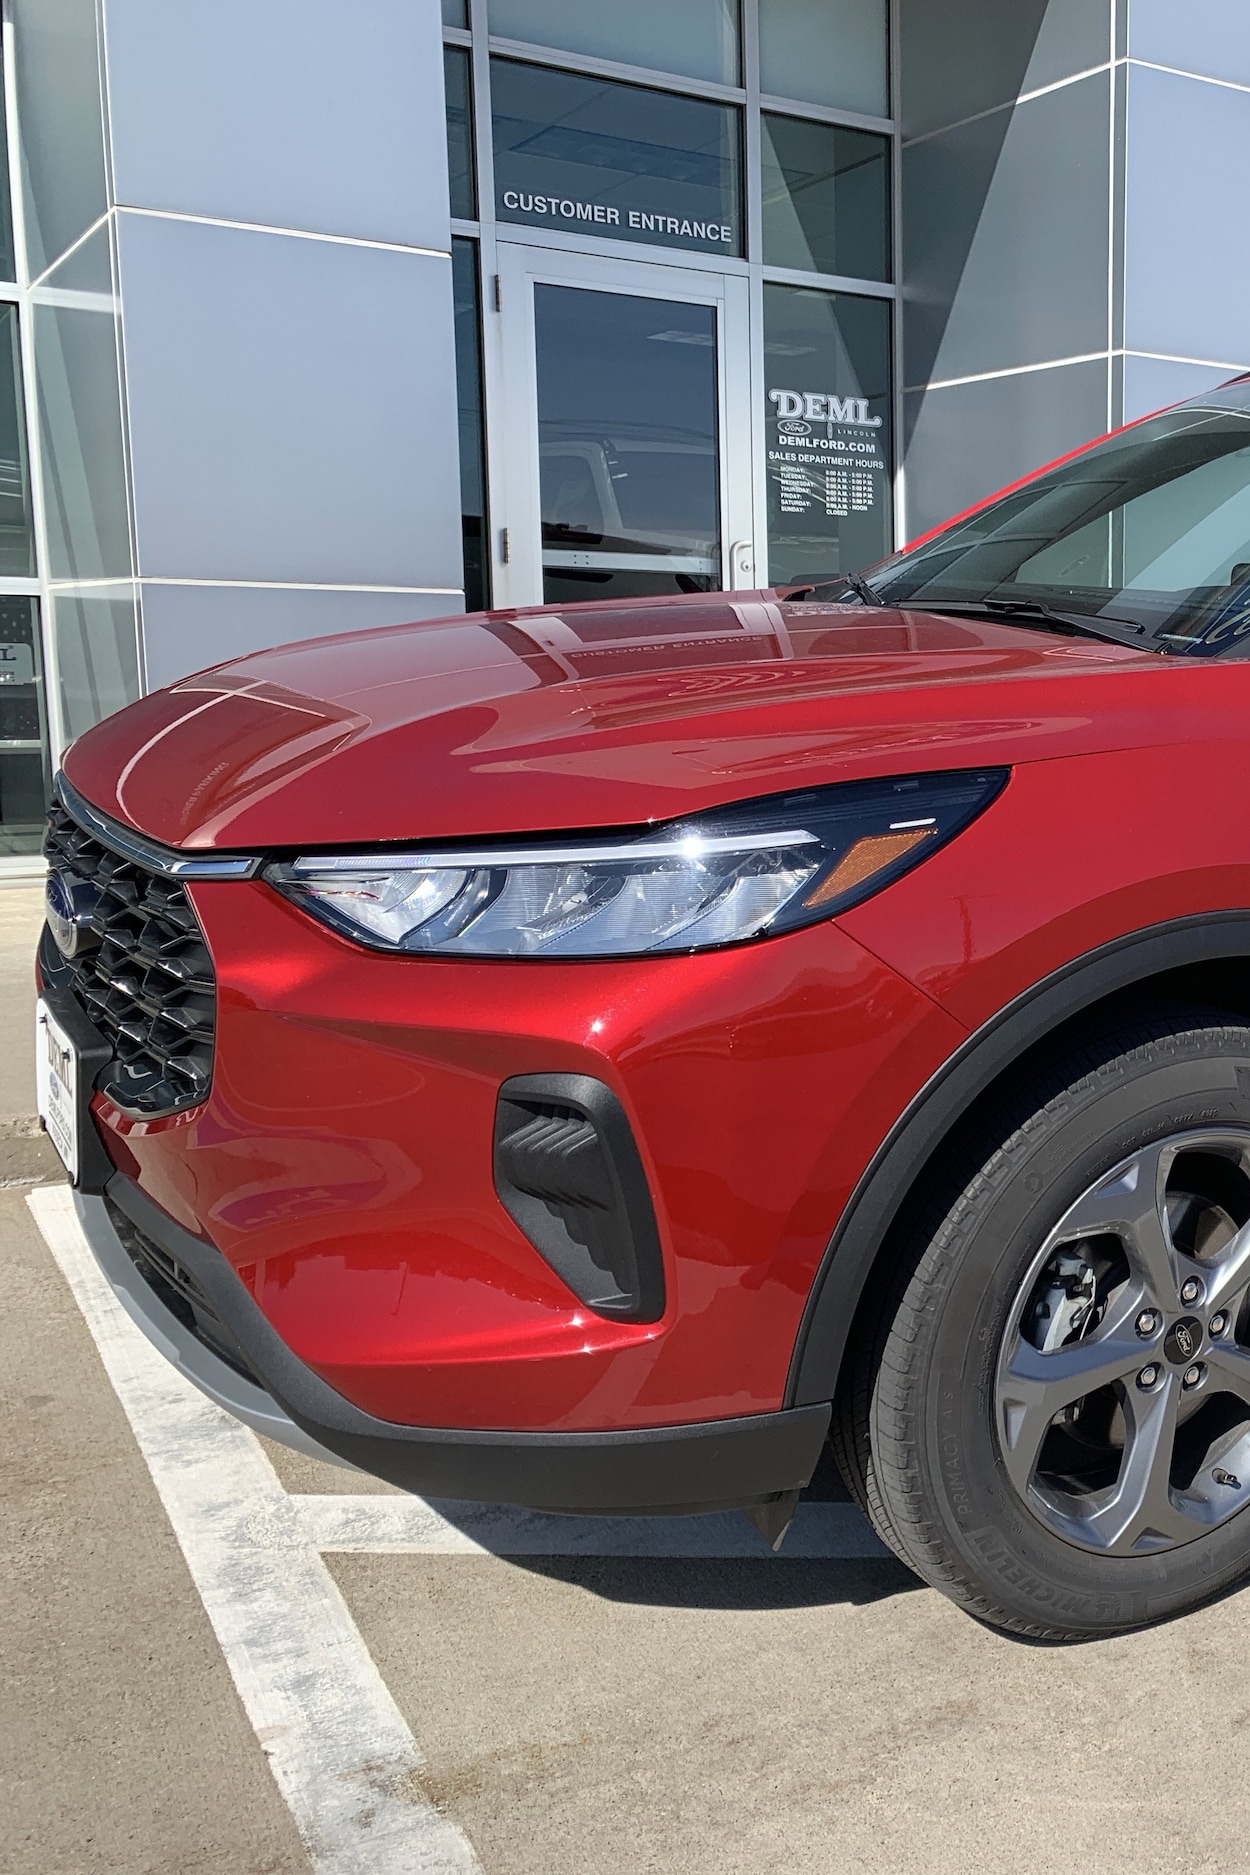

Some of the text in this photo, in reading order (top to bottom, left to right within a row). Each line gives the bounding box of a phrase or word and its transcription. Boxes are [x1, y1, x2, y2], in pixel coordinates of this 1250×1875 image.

[503, 191, 732, 242] CUSTOMER ENTRANCE
[768, 388, 883, 428] DEML
[779, 435, 876, 453] DEMLFORD.COM
[837, 429, 876, 438] LINCOLN
[768, 451, 884, 470] SALES DEPARTMENT HOURS
[1177, 1330, 1191, 1352] Ford
[975, 1532, 1090, 1614] MICHELIN
